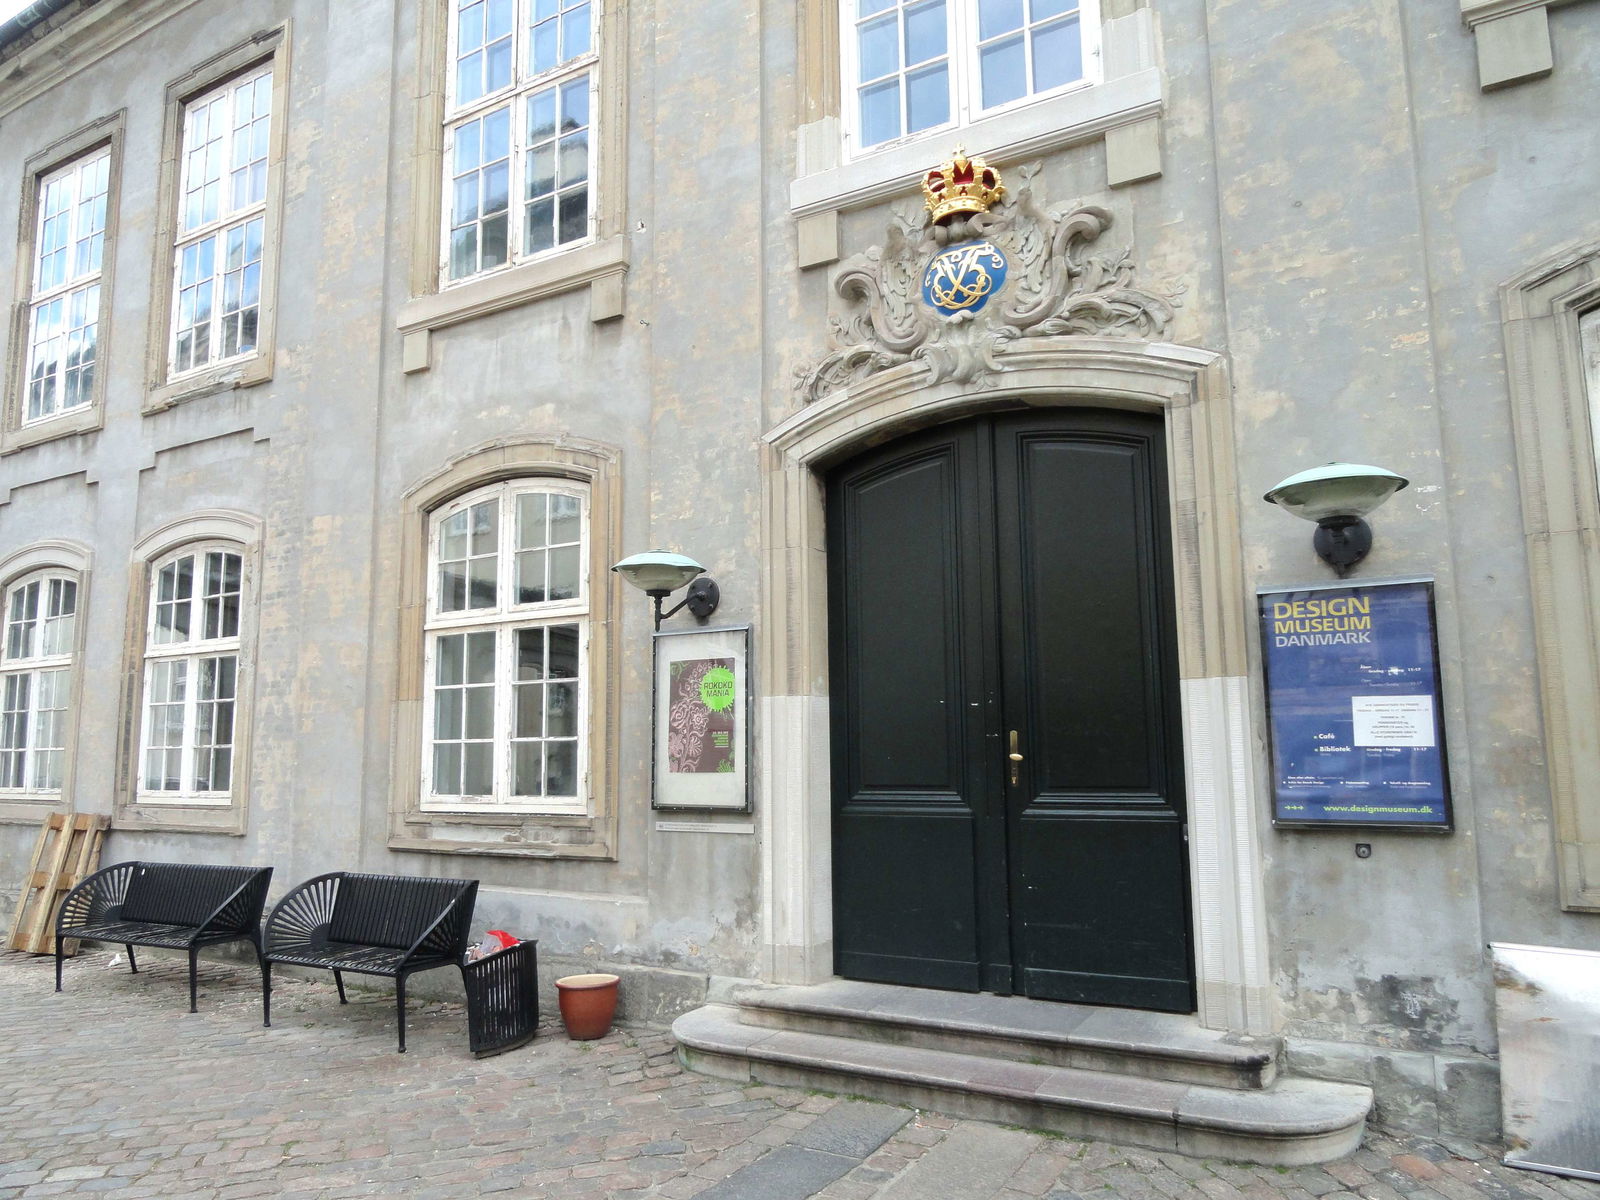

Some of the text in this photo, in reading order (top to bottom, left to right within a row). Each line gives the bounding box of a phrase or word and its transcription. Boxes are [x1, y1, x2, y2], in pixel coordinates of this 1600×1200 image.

[1273, 596, 1370, 619] DESIGN
[1274, 616, 1371, 634] MUSEUM
[1275, 631, 1371, 648] DANMARK
[703, 681, 733, 690] ROKOKO
[706, 689, 730, 698] MANIA
[1323, 804, 1433, 815] www.designmuseum.dk
